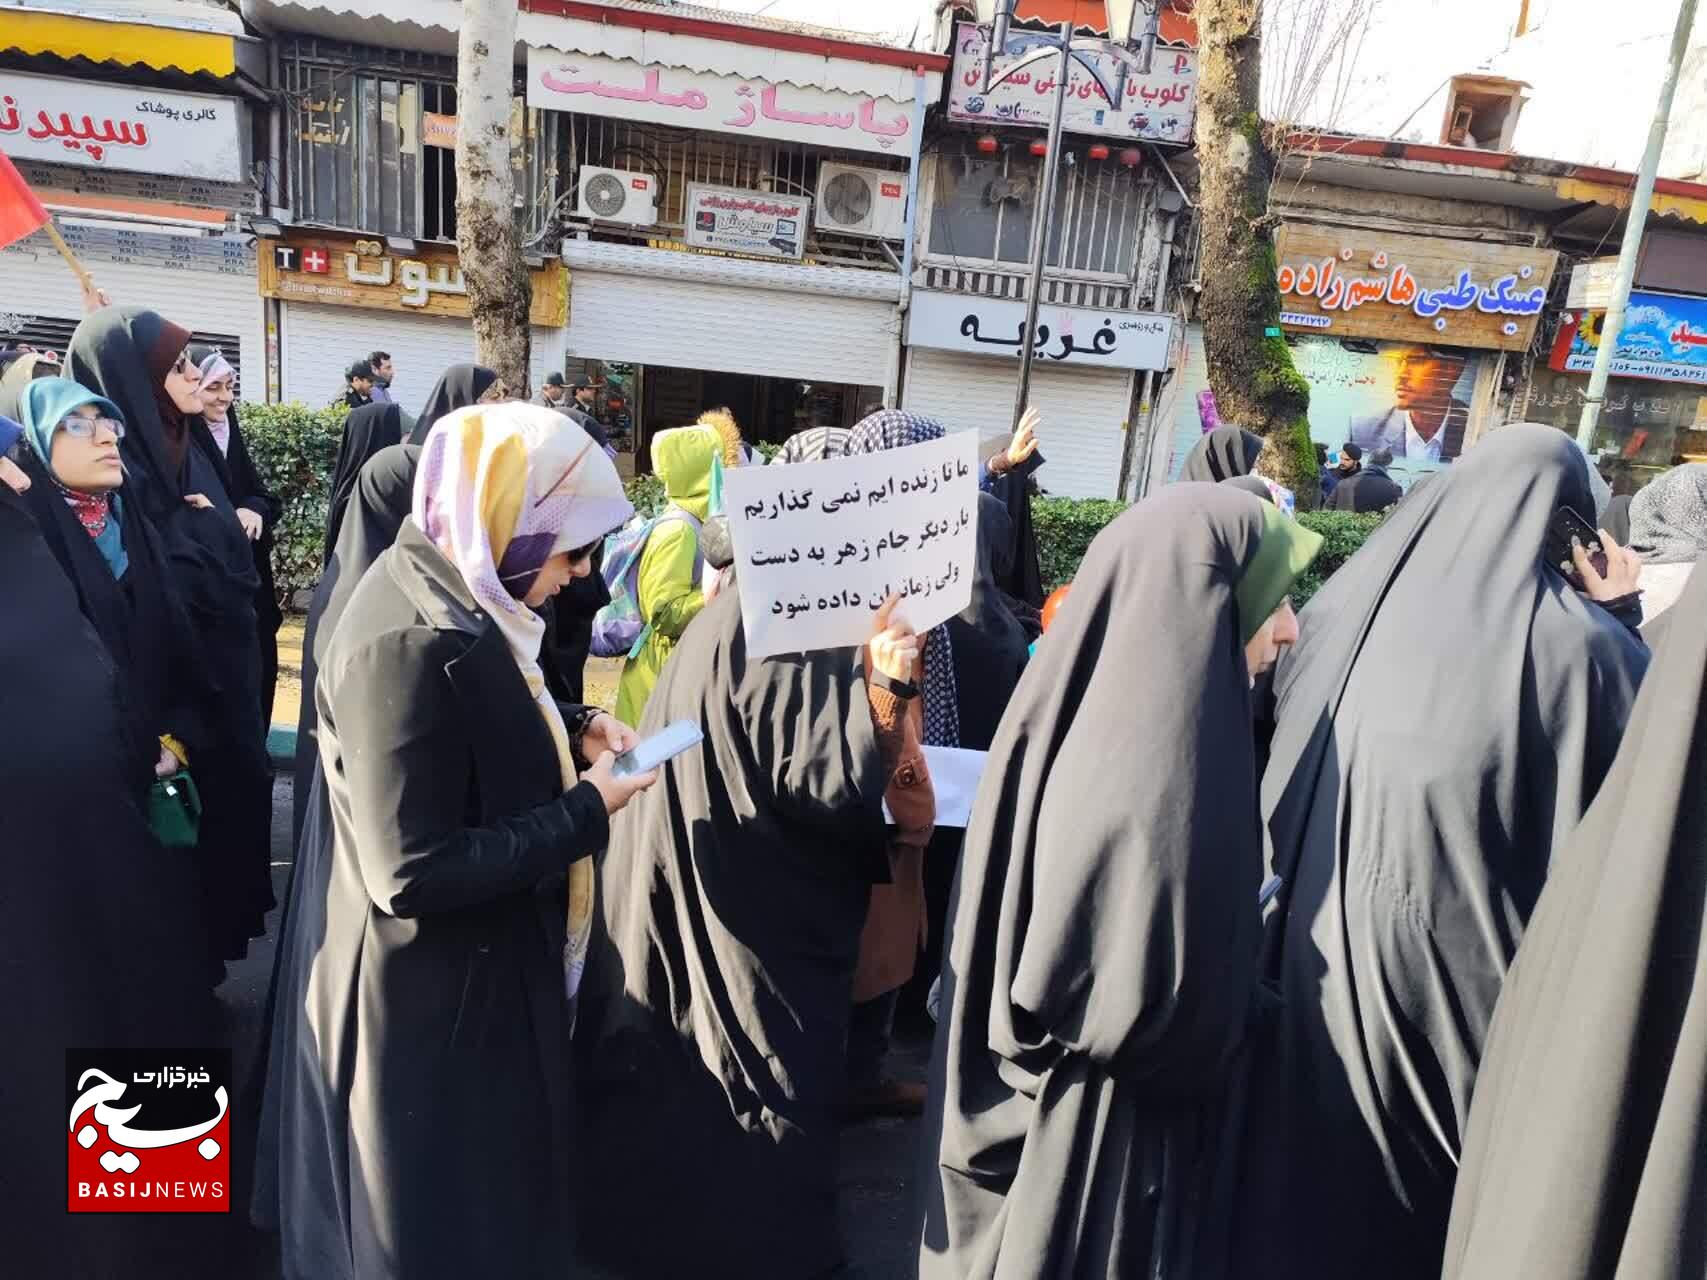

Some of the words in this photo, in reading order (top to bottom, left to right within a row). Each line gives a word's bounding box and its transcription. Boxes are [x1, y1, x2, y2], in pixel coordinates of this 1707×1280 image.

[540, 65, 708, 110] ملت
[1140, 82, 1190, 108] کلوپ
[135, 101, 180, 121] پوشاک
[722, 83, 909, 149] پاساژ
[1278, 248, 1353, 310] زاده
[1343, 252, 1416, 311] هاشم
[1415, 271, 1477, 332] طبی
[901, 468, 939, 493] زنده
[942, 462, 952, 482] تا
[957, 459, 969, 477] ما
[744, 489, 813, 520] گذاریم
[822, 482, 861, 514] نمی
[868, 478, 894, 507] ایم
[952, 508, 969, 534] بار
[877, 531, 909, 557] جام
[917, 519, 948, 550] دیگر
[751, 547, 800, 566] دست
[807, 546, 825, 564] به
[834, 538, 870, 565] زهر
[935, 561, 960, 591] ولی
[771, 594, 811, 619] شود
[817, 590, 861, 610] داده
